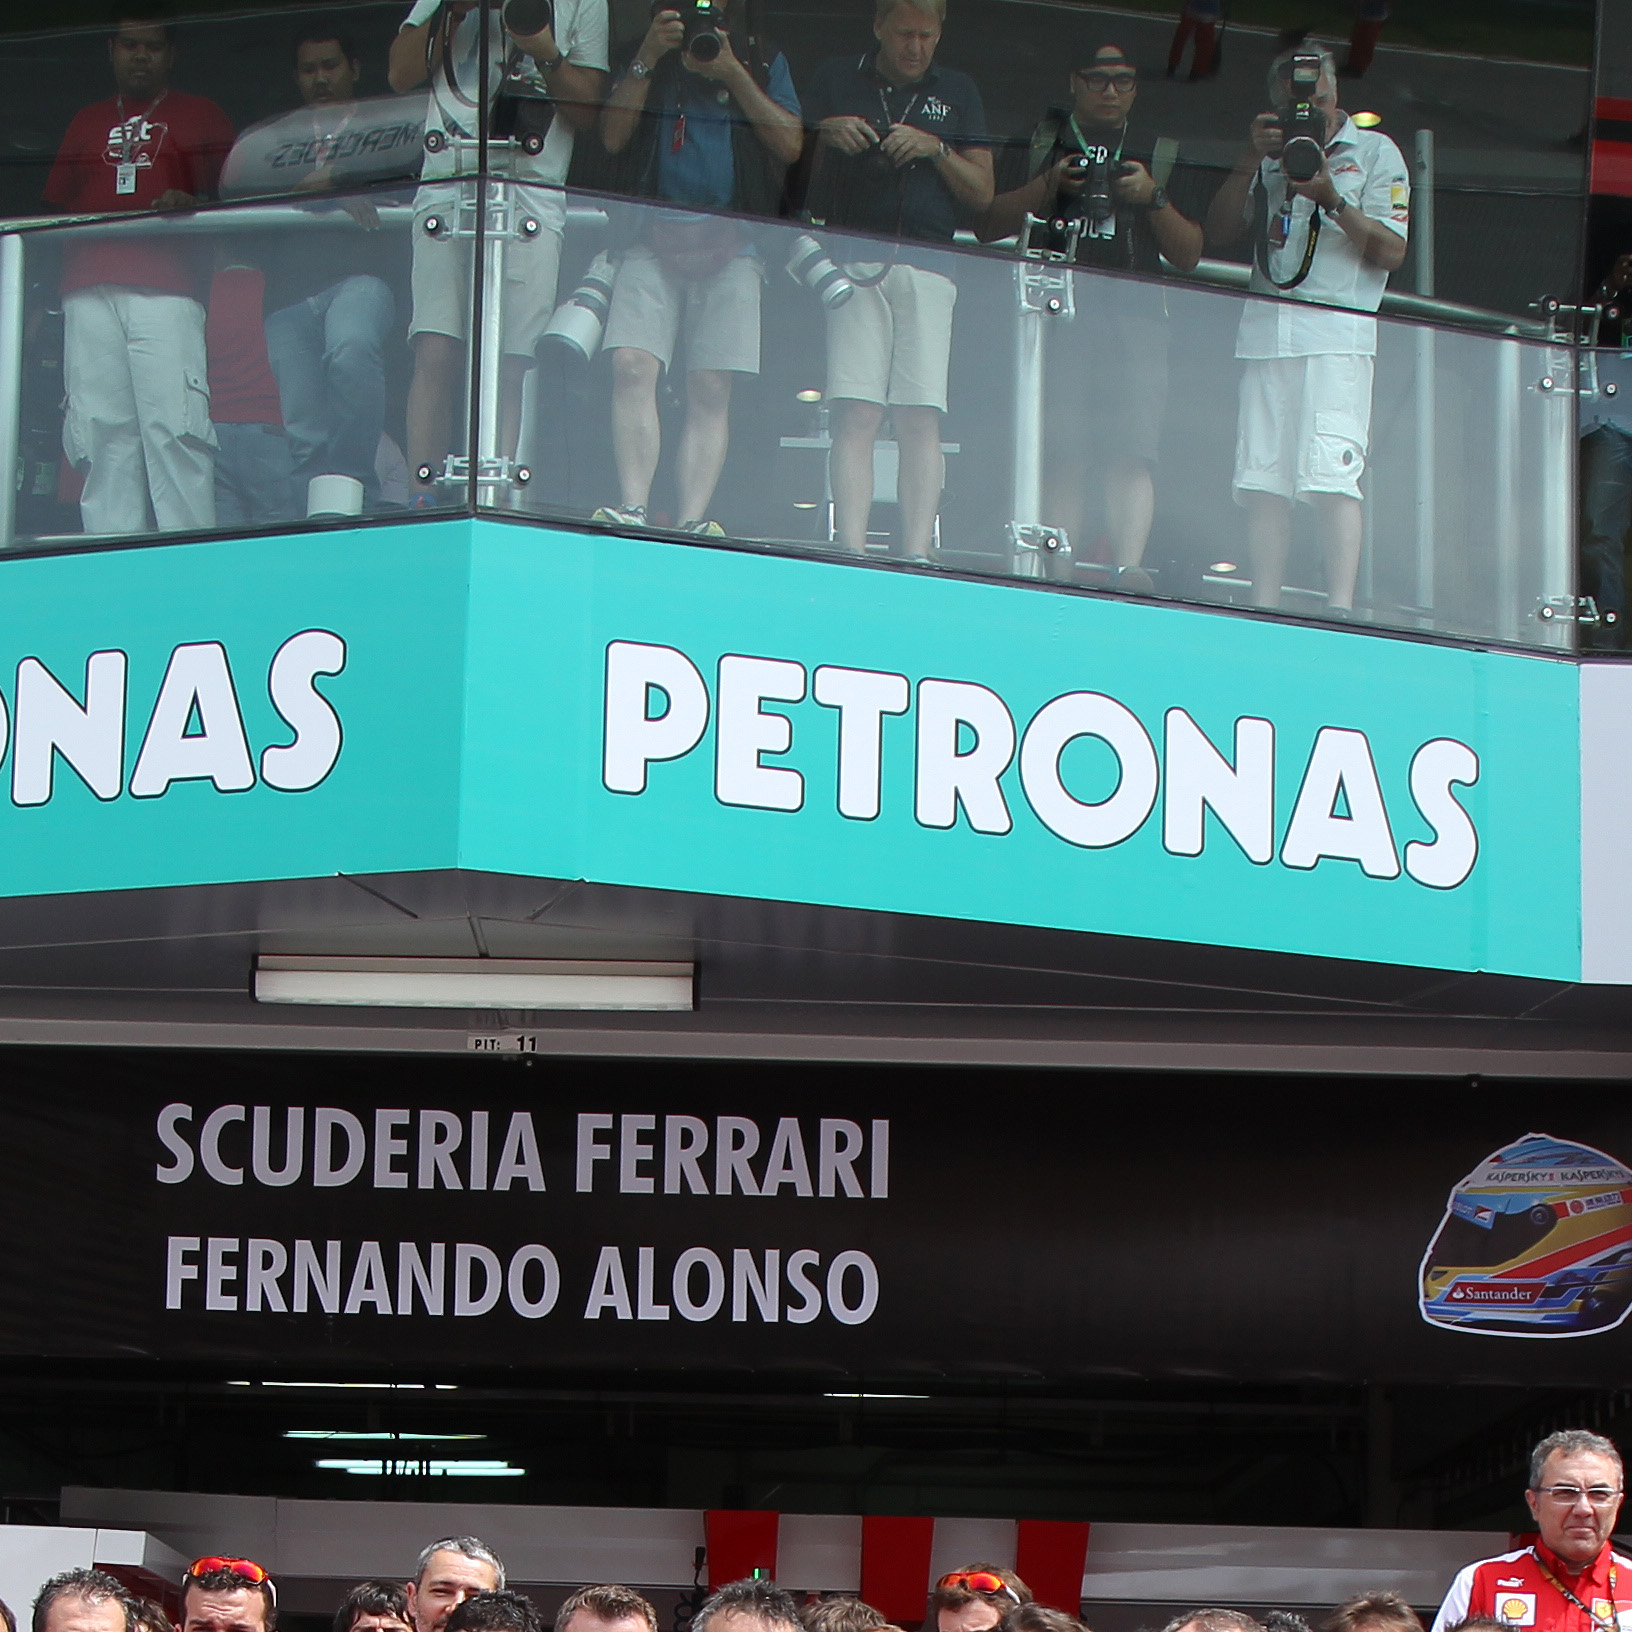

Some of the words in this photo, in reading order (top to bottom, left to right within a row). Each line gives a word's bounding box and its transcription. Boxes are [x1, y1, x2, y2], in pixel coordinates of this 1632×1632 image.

[602, 640, 1480, 890] PETRONAS
[474, 1038, 501, 1051] PIT:
[516, 1034, 537, 1052] 11
[156, 1102, 547, 1192] SCUDERIA
[575, 1112, 890, 1199] FERRARI
[164, 1235, 560, 1319] FERNANDO
[583, 1245, 880, 1325] ALONSO
[1465, 1286, 1532, 1301] Santander
